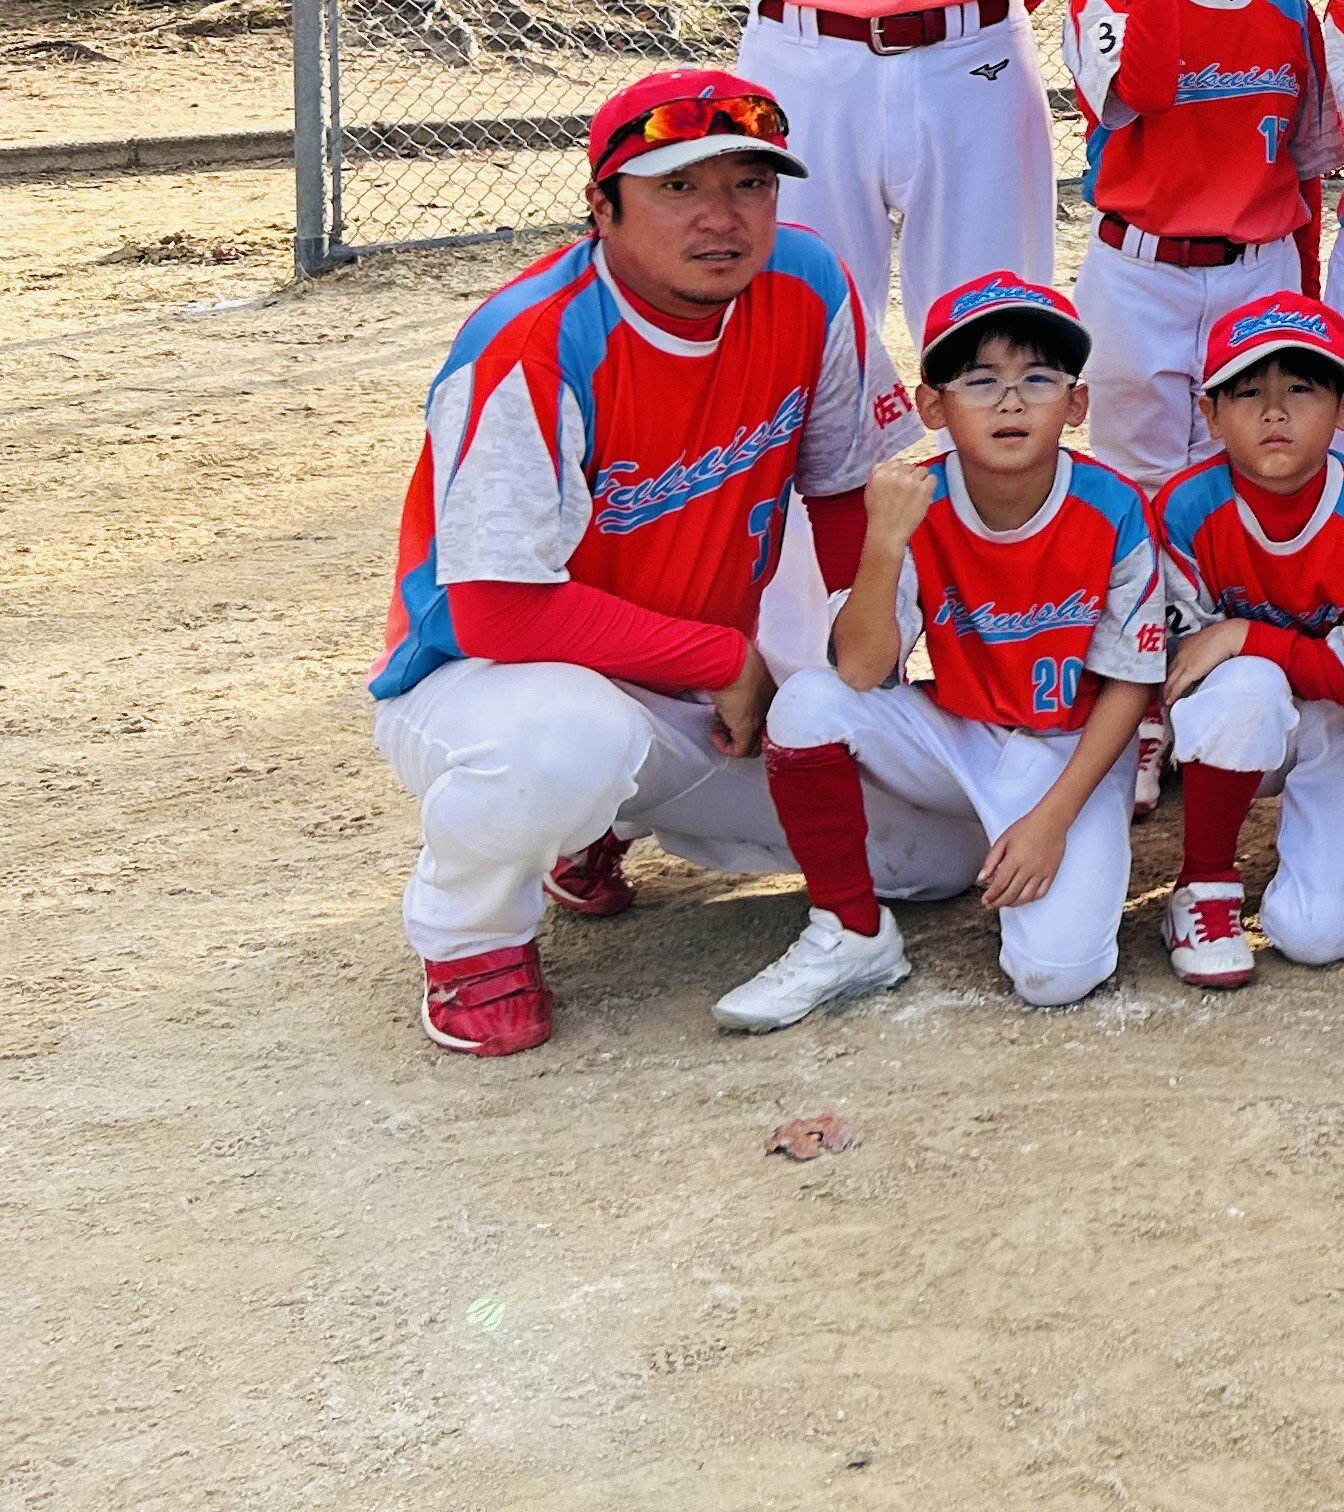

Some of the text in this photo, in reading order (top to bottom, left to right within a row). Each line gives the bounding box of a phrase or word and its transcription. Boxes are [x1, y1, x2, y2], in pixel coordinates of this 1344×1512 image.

[1098, 22, 1117, 54] 3
[1174, 59, 1300, 105] ukuishi
[1031, 656, 1084, 714] 20
